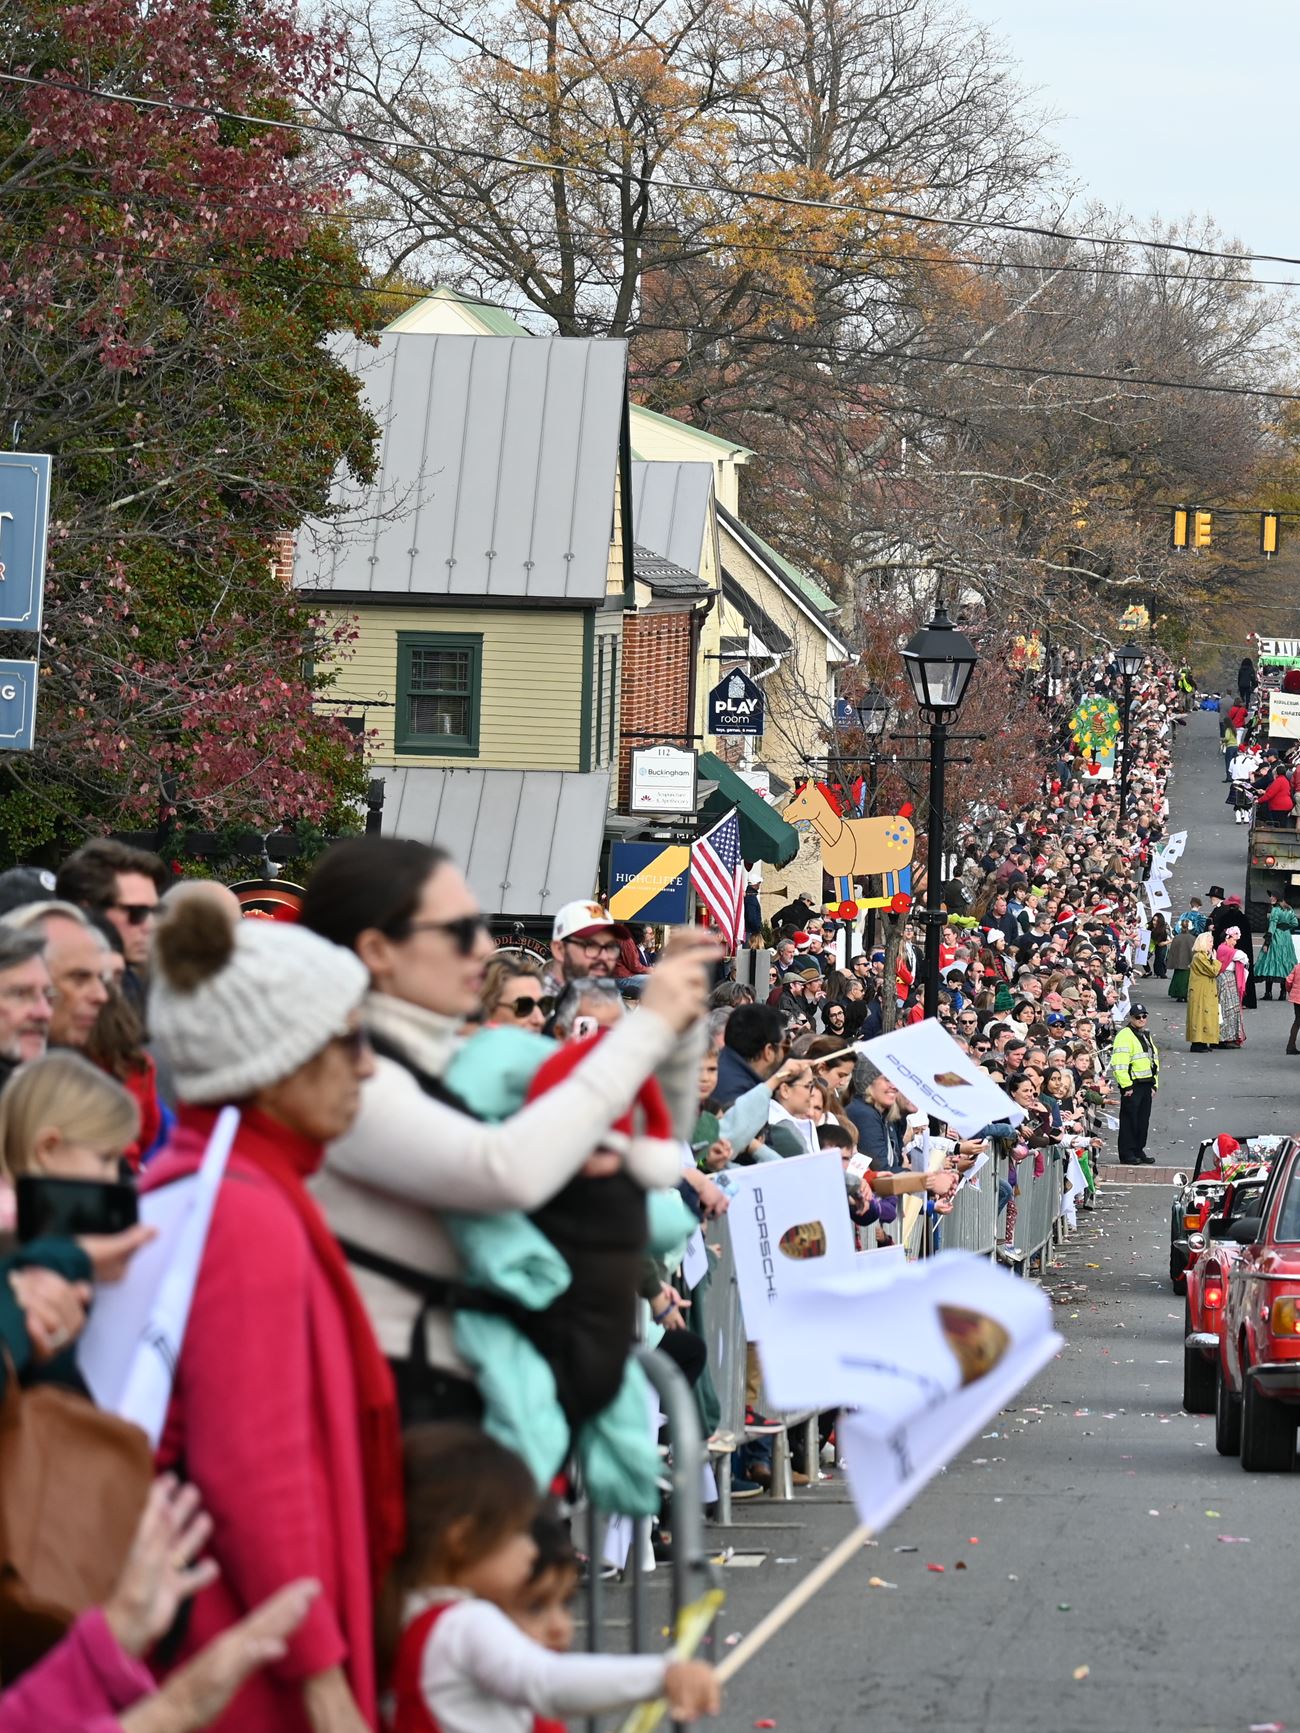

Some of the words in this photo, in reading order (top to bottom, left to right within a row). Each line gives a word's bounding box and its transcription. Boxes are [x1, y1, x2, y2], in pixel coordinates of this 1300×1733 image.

[715, 699, 758, 714] PLAY
[720, 715, 749, 723] room
[648, 768, 690, 777] Buckingham
[886, 1053, 968, 1117] PORSCHE
[753, 1187, 778, 1304] PORSCHE
